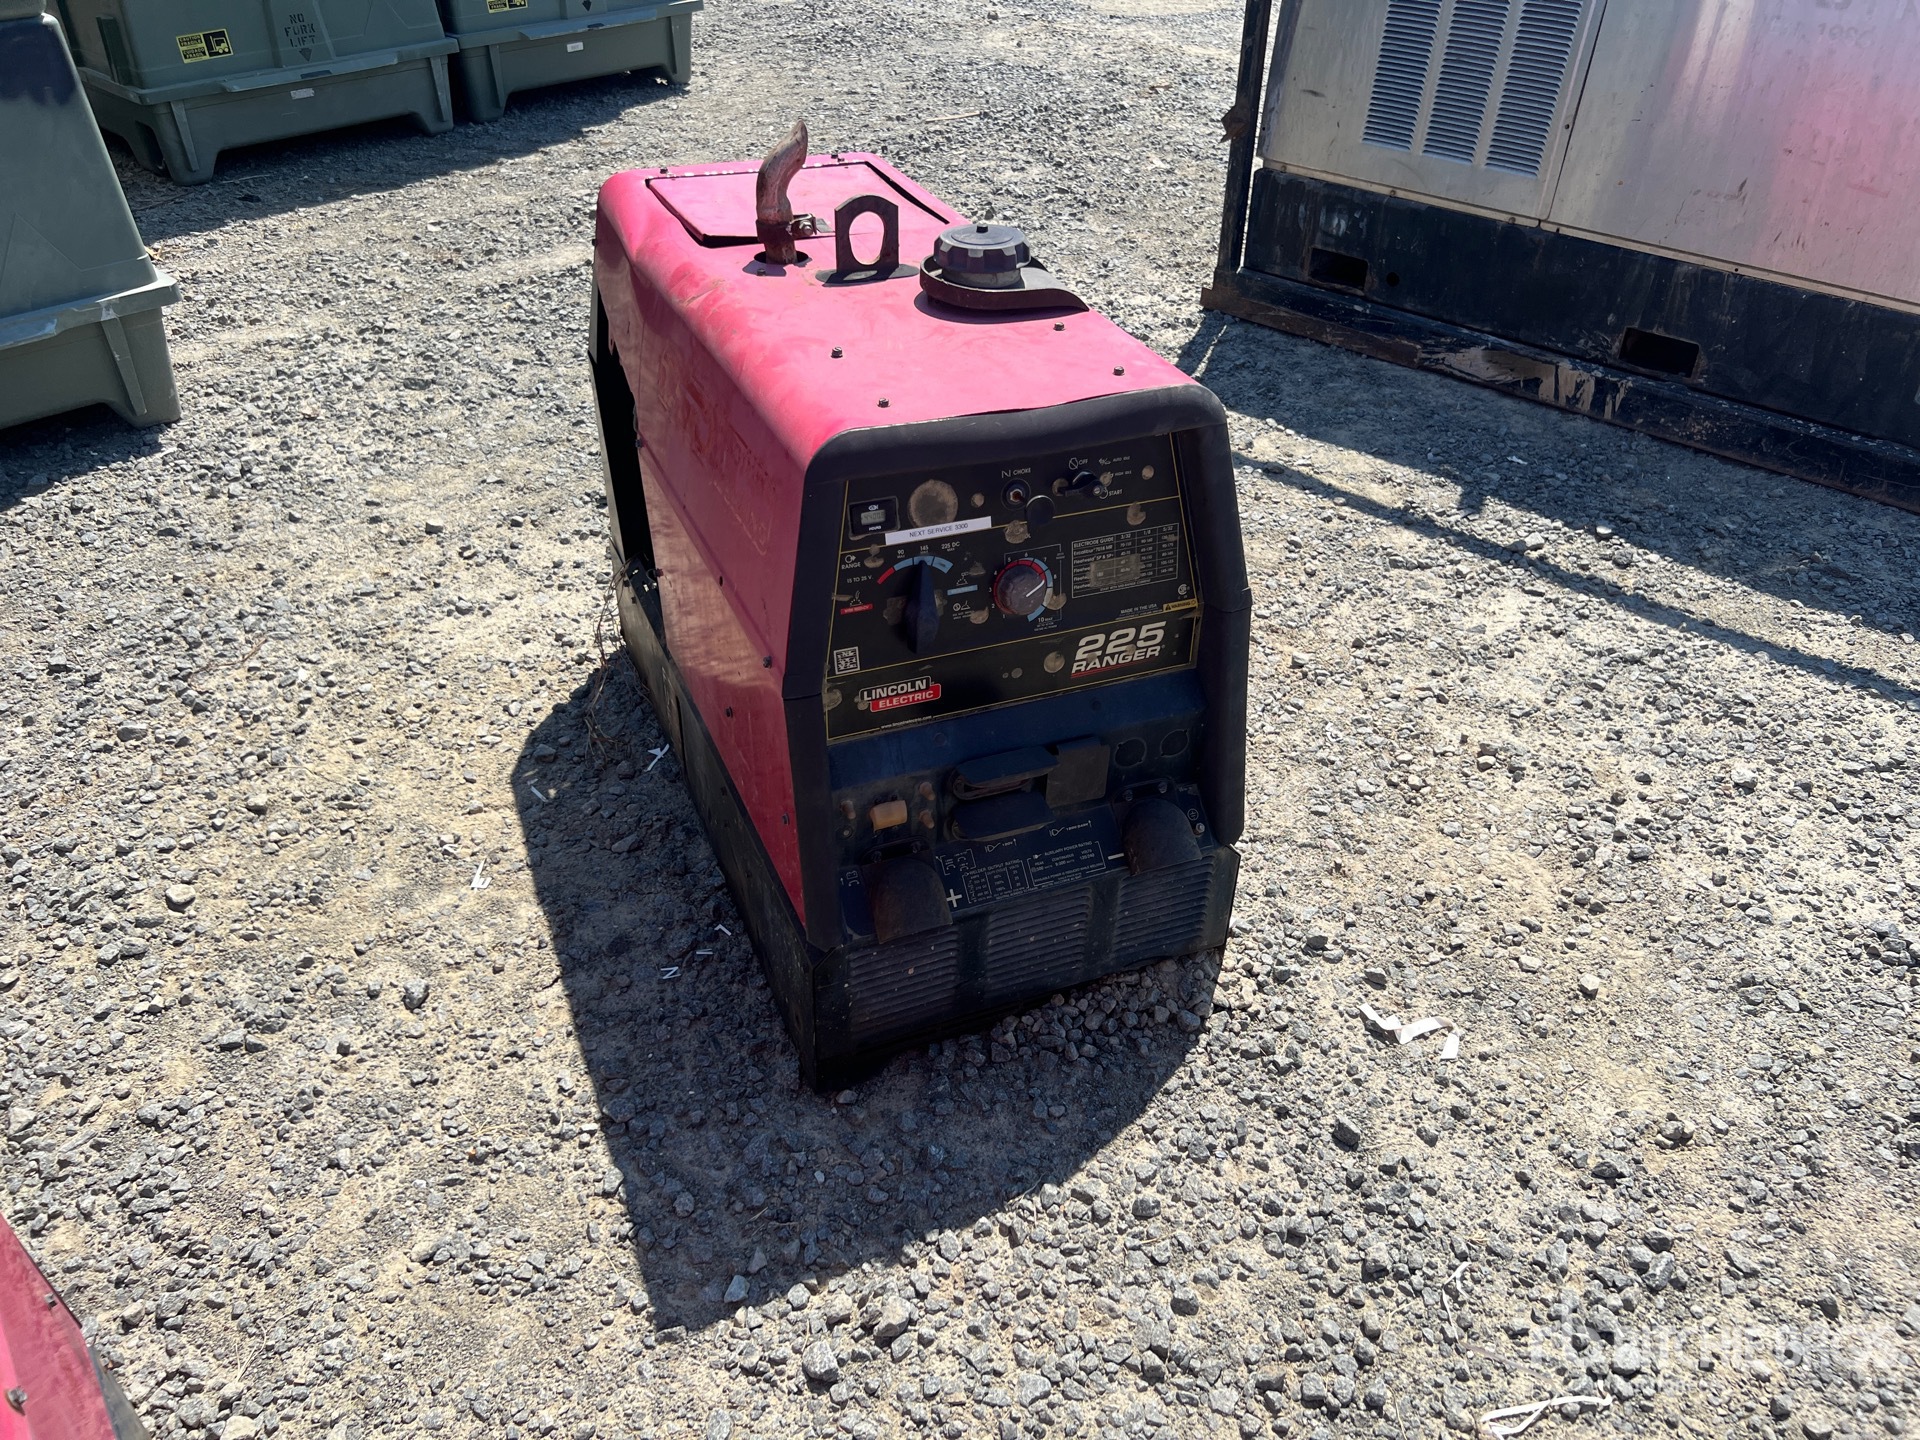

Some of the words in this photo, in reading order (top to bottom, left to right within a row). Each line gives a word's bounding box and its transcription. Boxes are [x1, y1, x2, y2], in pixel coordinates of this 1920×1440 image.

[289, 12, 305, 24] NO
[284, 23, 316, 37] FORK
[289, 35, 316, 48] LIFT
[183, 47, 205, 55] CUIDADO
[1079, 458, 1088, 466] OFF
[1013, 468, 1031, 476] CHOKE
[1108, 488, 1123, 497] START
[909, 530, 925, 538] NEXT
[927, 526, 953, 535] SERVICE
[954, 522, 968, 530] 3300
[1074, 540, 1099, 548] ELECTRODE
[1100, 536, 1114, 544] GUIDE
[841, 562, 861, 570] RANGE
[1075, 620, 1167, 661] 225
[1072, 645, 1161, 674] RANGER
[863, 678, 927, 702] LINCOLN
[878, 690, 934, 709] ELECTRIC
[1044, 848, 1064, 856] AUXILIARY
[1078, 840, 1093, 848] RATING
[987, 862, 1004, 870] OUTPUT
